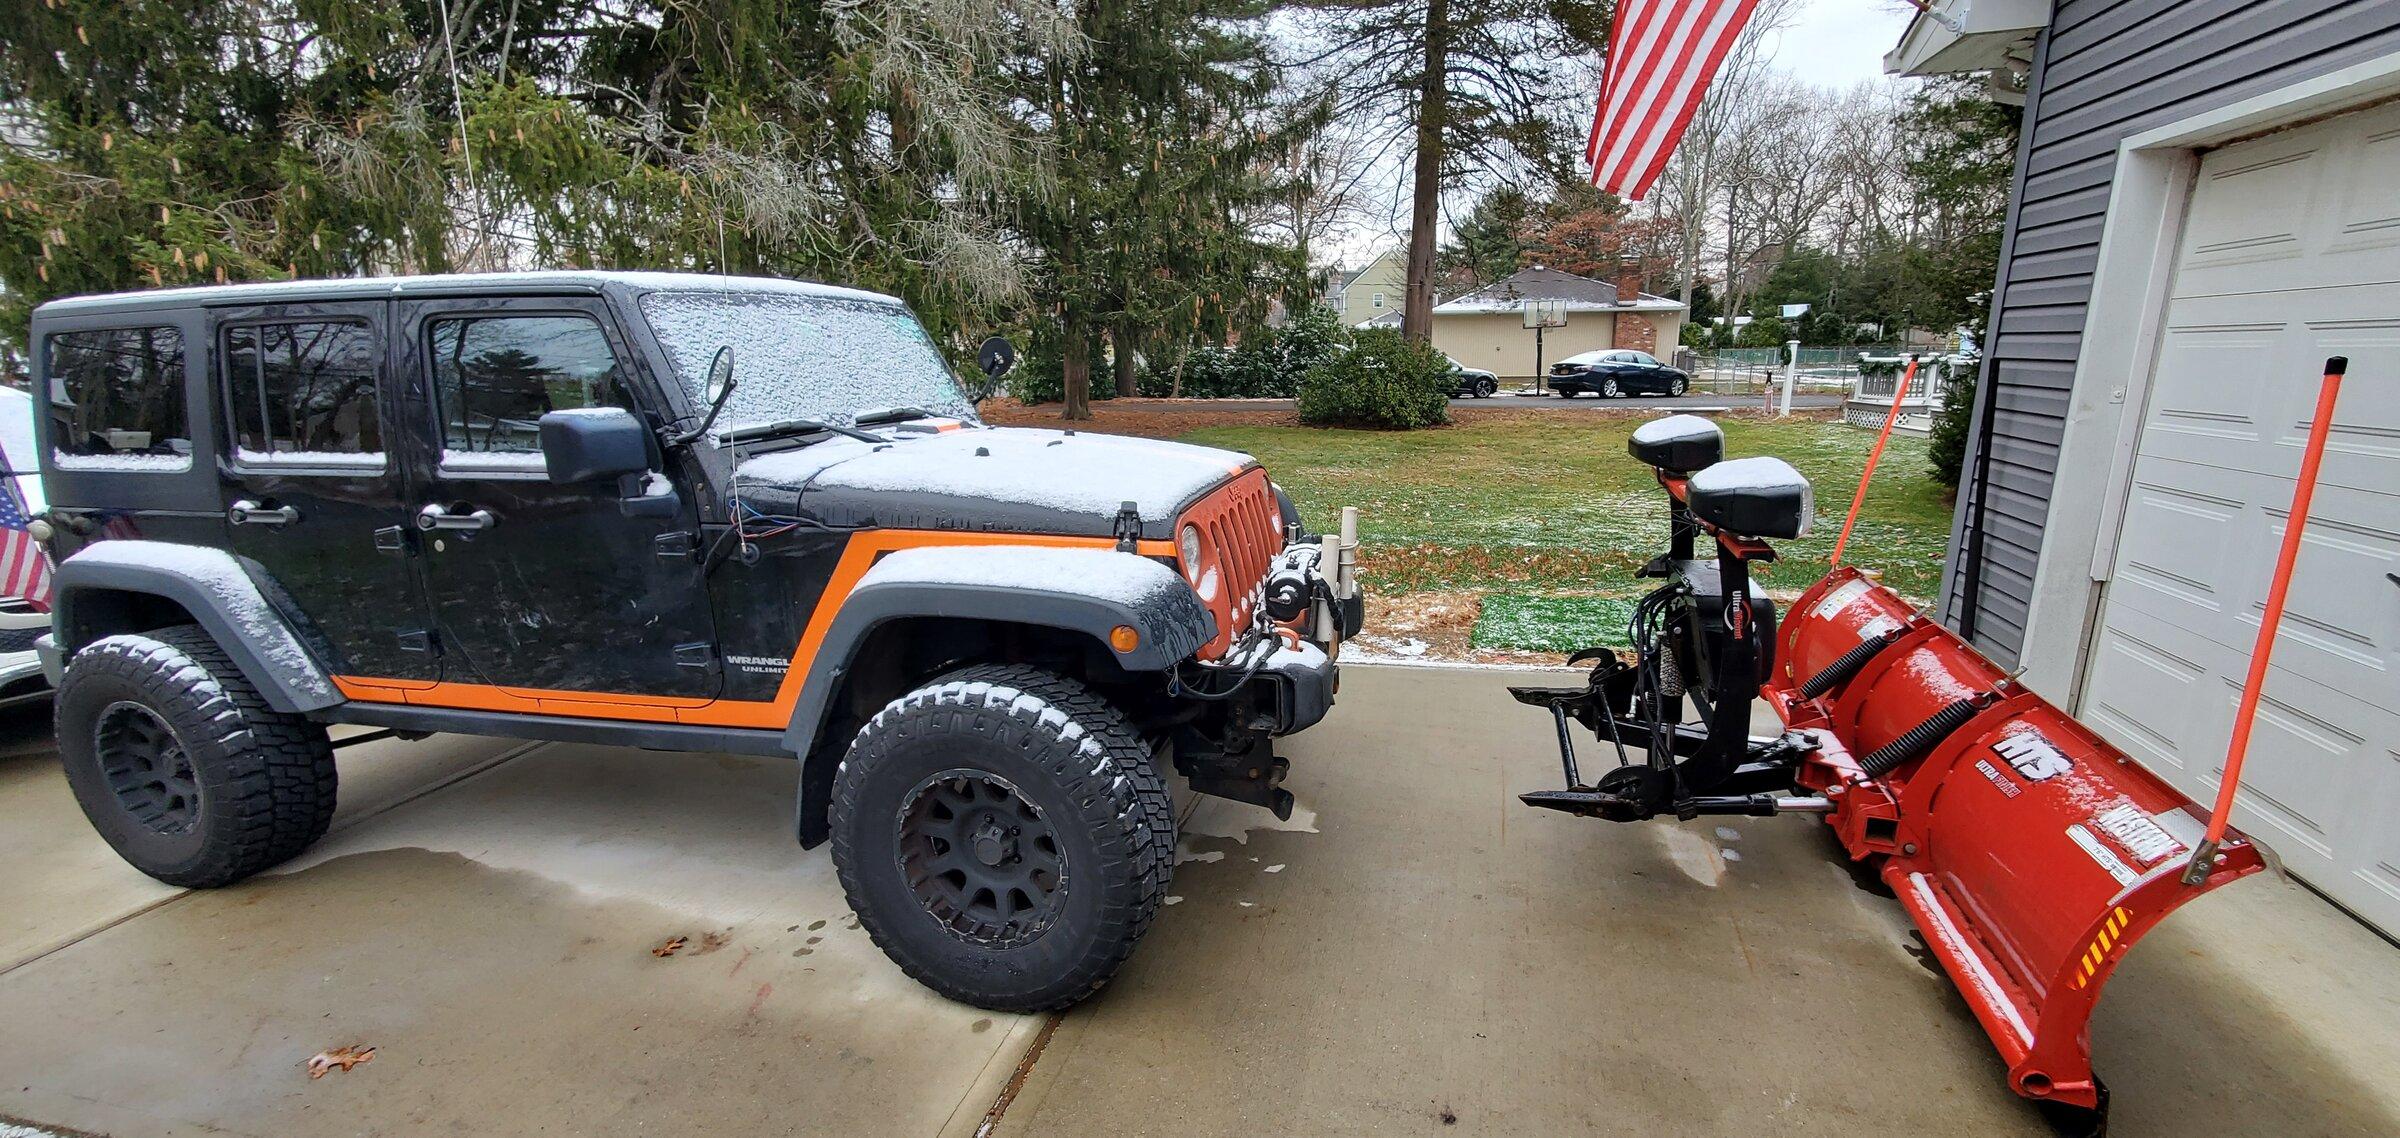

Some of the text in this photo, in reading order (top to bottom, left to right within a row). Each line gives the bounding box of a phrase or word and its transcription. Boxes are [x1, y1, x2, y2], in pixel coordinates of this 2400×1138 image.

[727, 655, 791, 666] WRANGL
[741, 665, 788, 674] UNLIMIT
[1990, 730, 2075, 782] HTS
